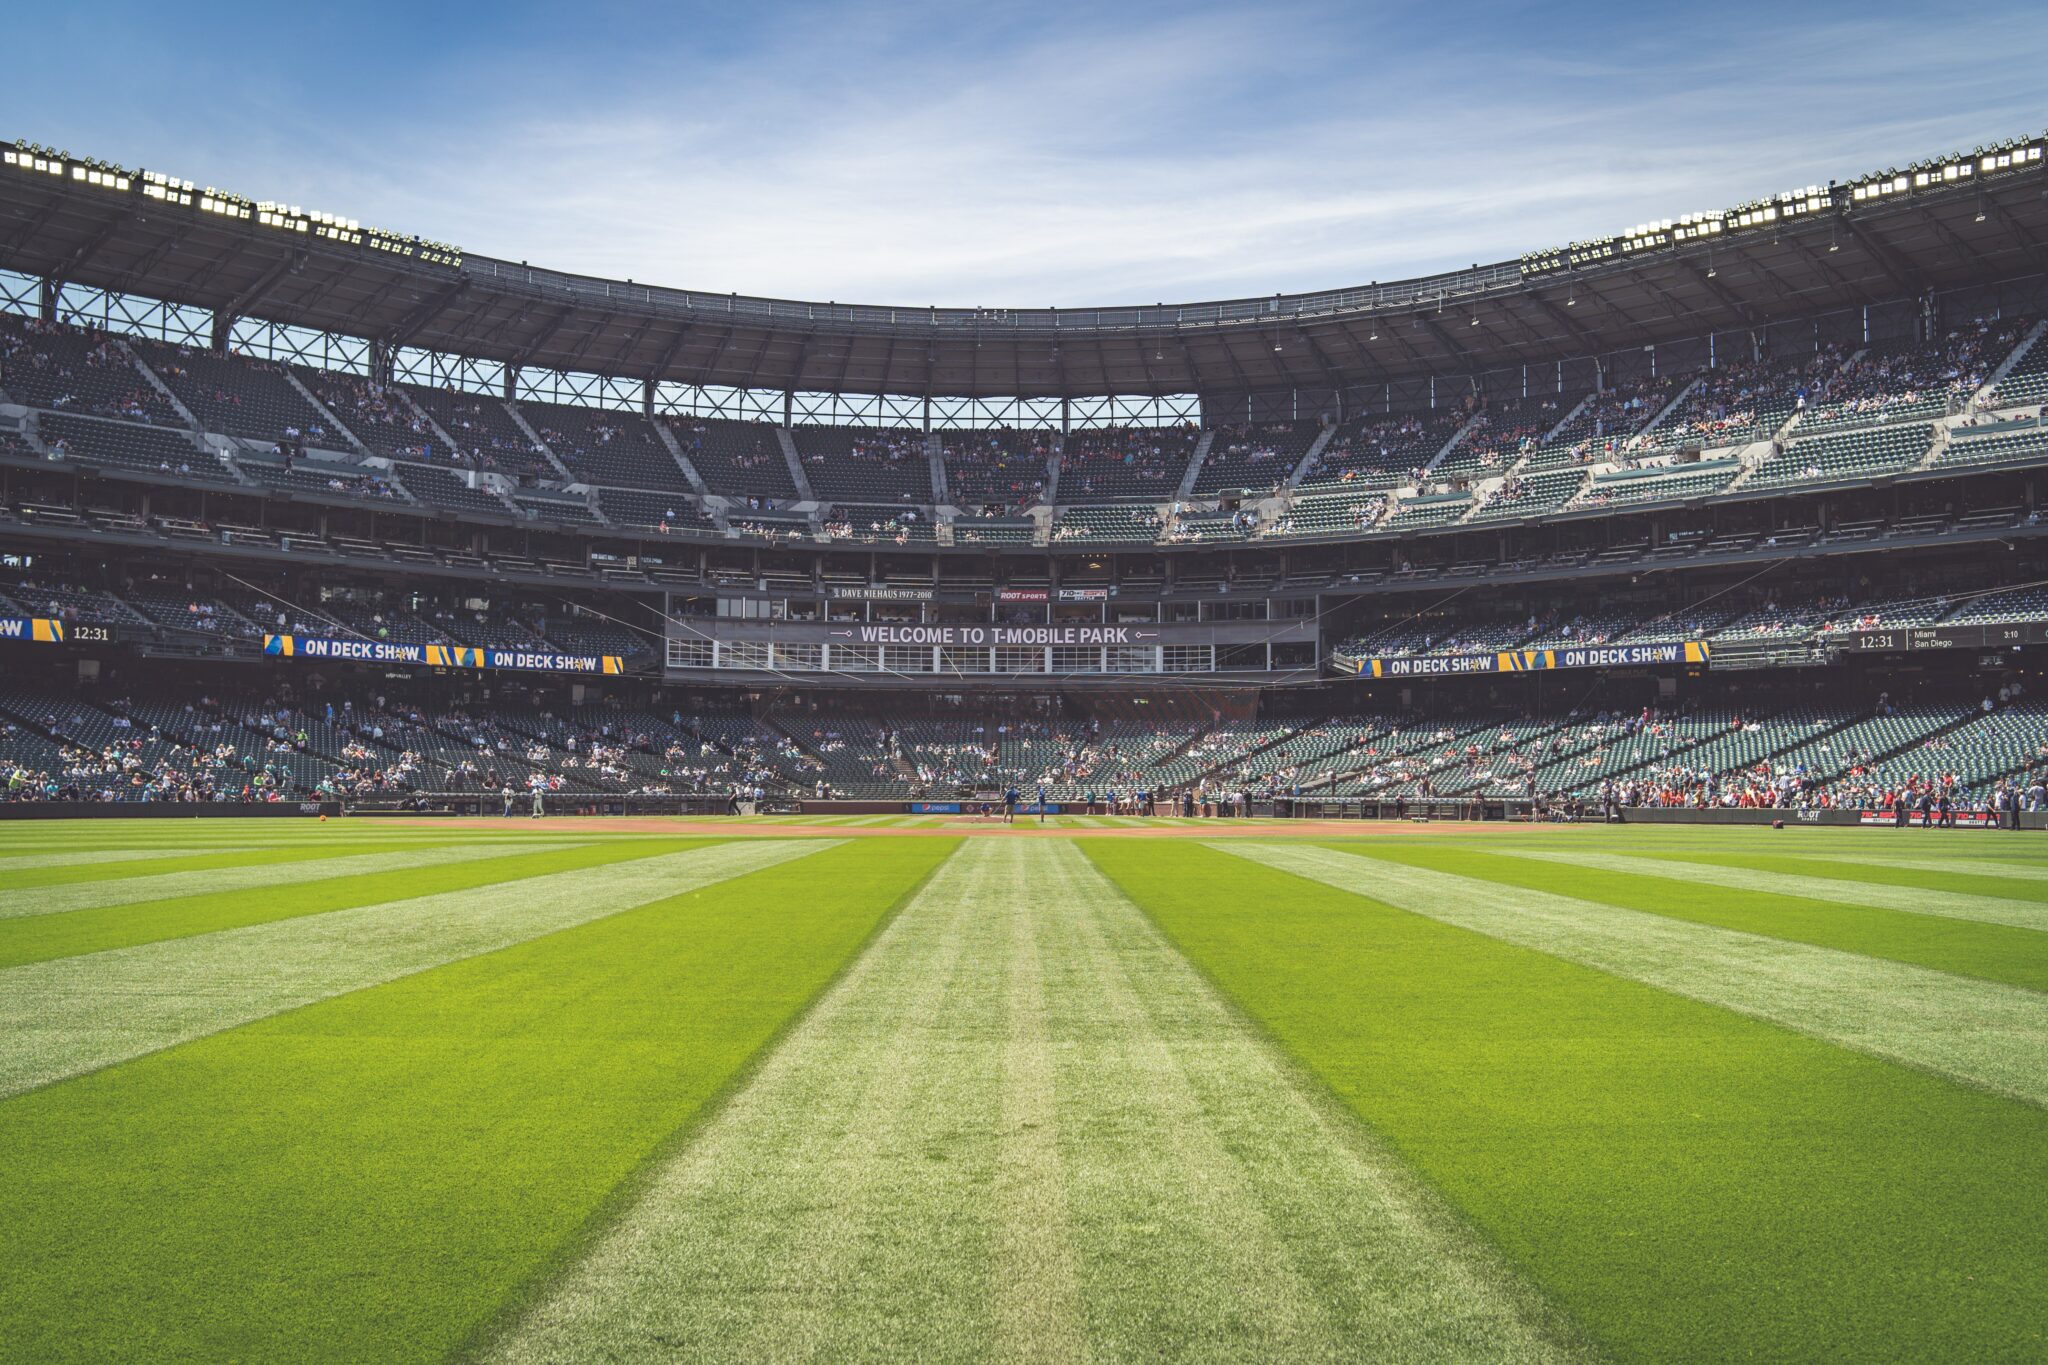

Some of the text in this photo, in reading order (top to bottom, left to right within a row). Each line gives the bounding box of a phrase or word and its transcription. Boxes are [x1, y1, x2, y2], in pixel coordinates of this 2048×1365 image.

[841, 589, 932, 599] DAVE NIEHAUS 1977-2010
[74, 626, 109, 641] 12:31
[860, 626, 1129, 644] WELCOME TO T-MOBILE PARK
[1914, 630, 1936, 639] Miami
[2003, 630, 2019, 639] 3:10
[305, 639, 328, 656] ON
[331, 641, 372, 659] DECK
[1860, 634, 1894, 649] 12:31
[1914, 639, 1953, 648] San Diego
[494, 651, 514, 667] ON
[516, 653, 553, 669] DECK
[1565, 651, 1586, 666] ON
[1589, 648, 1629, 664] DECK
[1391, 661, 1410, 674] ON
[1413, 658, 1449, 673] DECK
[300, 803, 321, 811] ROOT
[931, 804, 949, 812] pepsi
